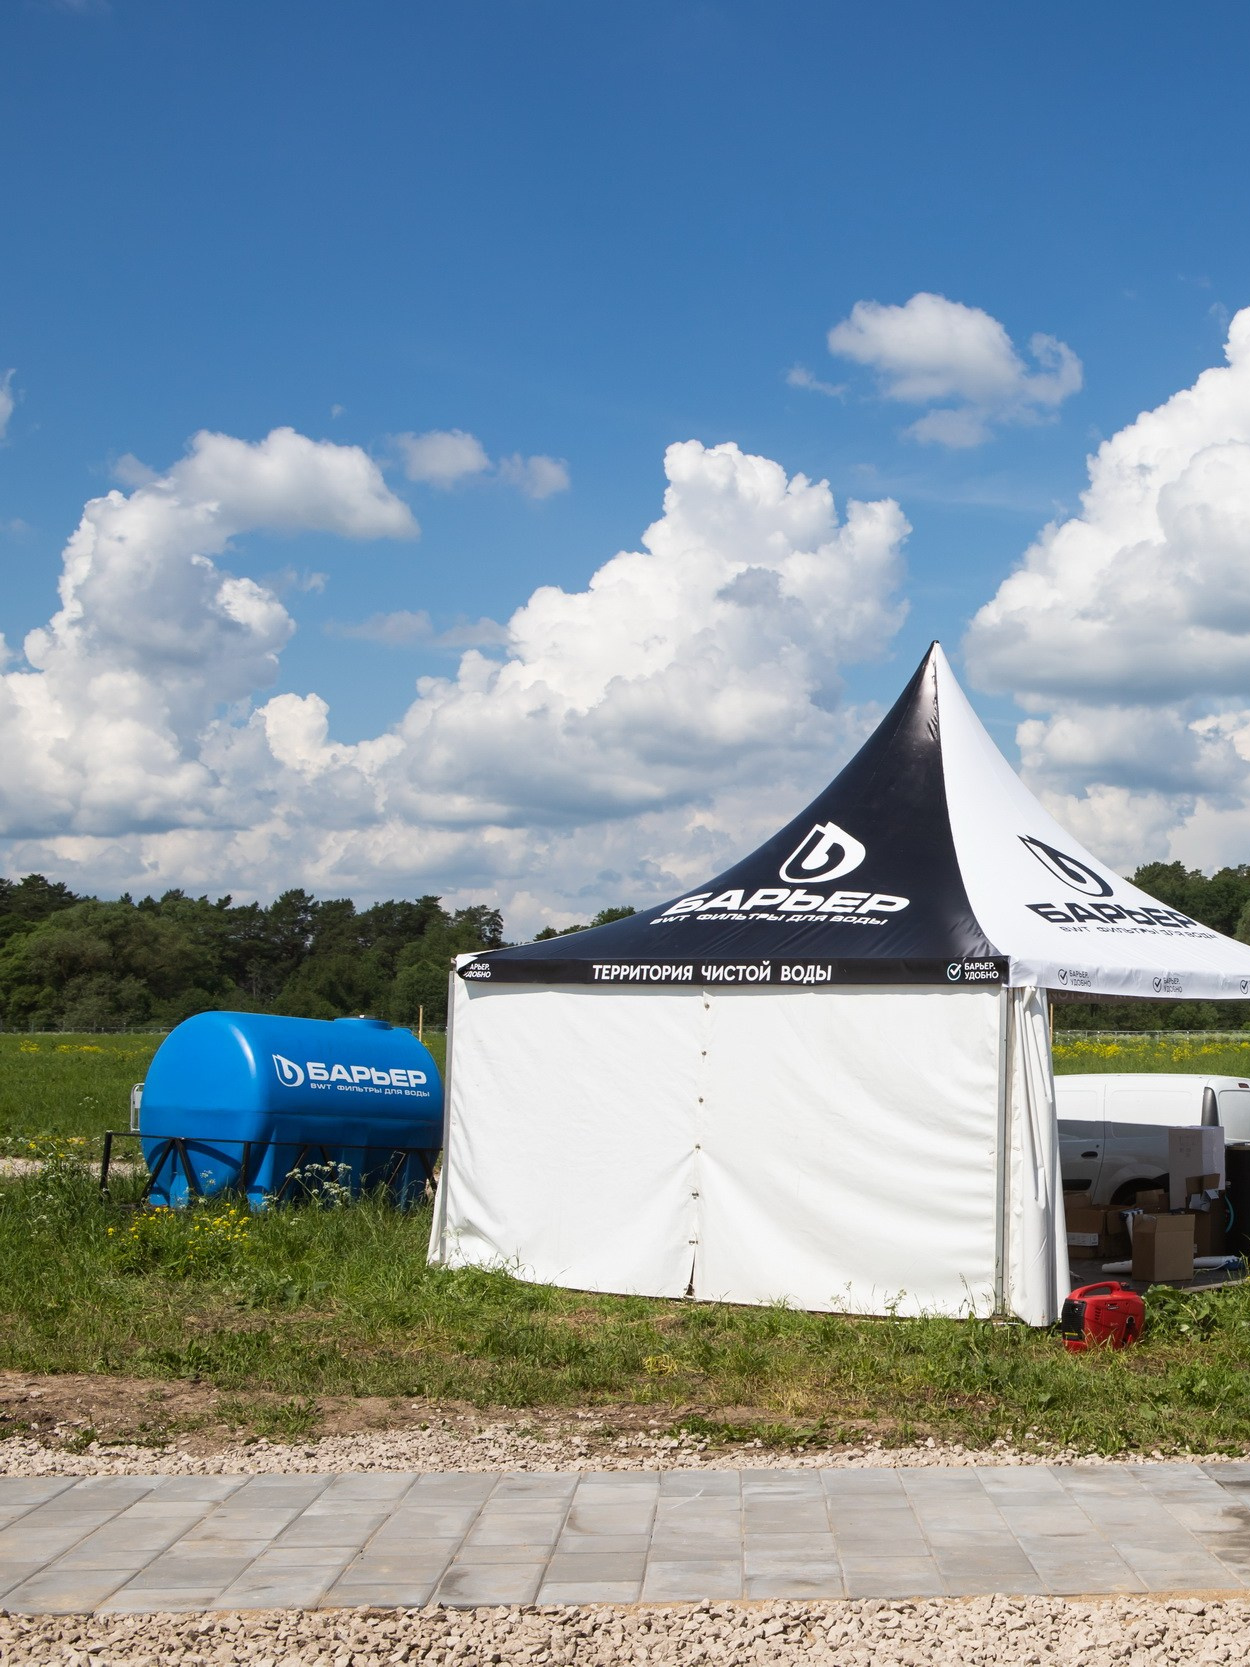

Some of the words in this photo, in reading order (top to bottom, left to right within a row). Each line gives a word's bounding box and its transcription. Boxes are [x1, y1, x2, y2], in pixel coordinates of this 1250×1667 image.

[661, 888, 910, 916] БАРЬЕР
[696, 913, 786, 923] ФИЛЬТРЫ
[786, 914, 828, 923] ДЛЯ
[829, 915, 888, 925] ВОДЫ
[1025, 903, 1198, 929] БАРЬЕР
[466, 963, 490, 971] АРЬЕР.
[592, 965, 693, 981] ТЕРРИТОРИЯ
[701, 960, 771, 981] ЧИСТОЙ
[780, 965, 832, 984] ВОДЫ
[964, 962, 996, 970] БАРЬЕР.
[964, 971, 999, 980] УДОБНО
[306, 1062, 427, 1087] БАРЬЕР
[310, 1082, 332, 1090] BWT
[336, 1084, 382, 1094] ФИЛЬТРЫ
[404, 1089, 430, 1097] ВОДЫ
